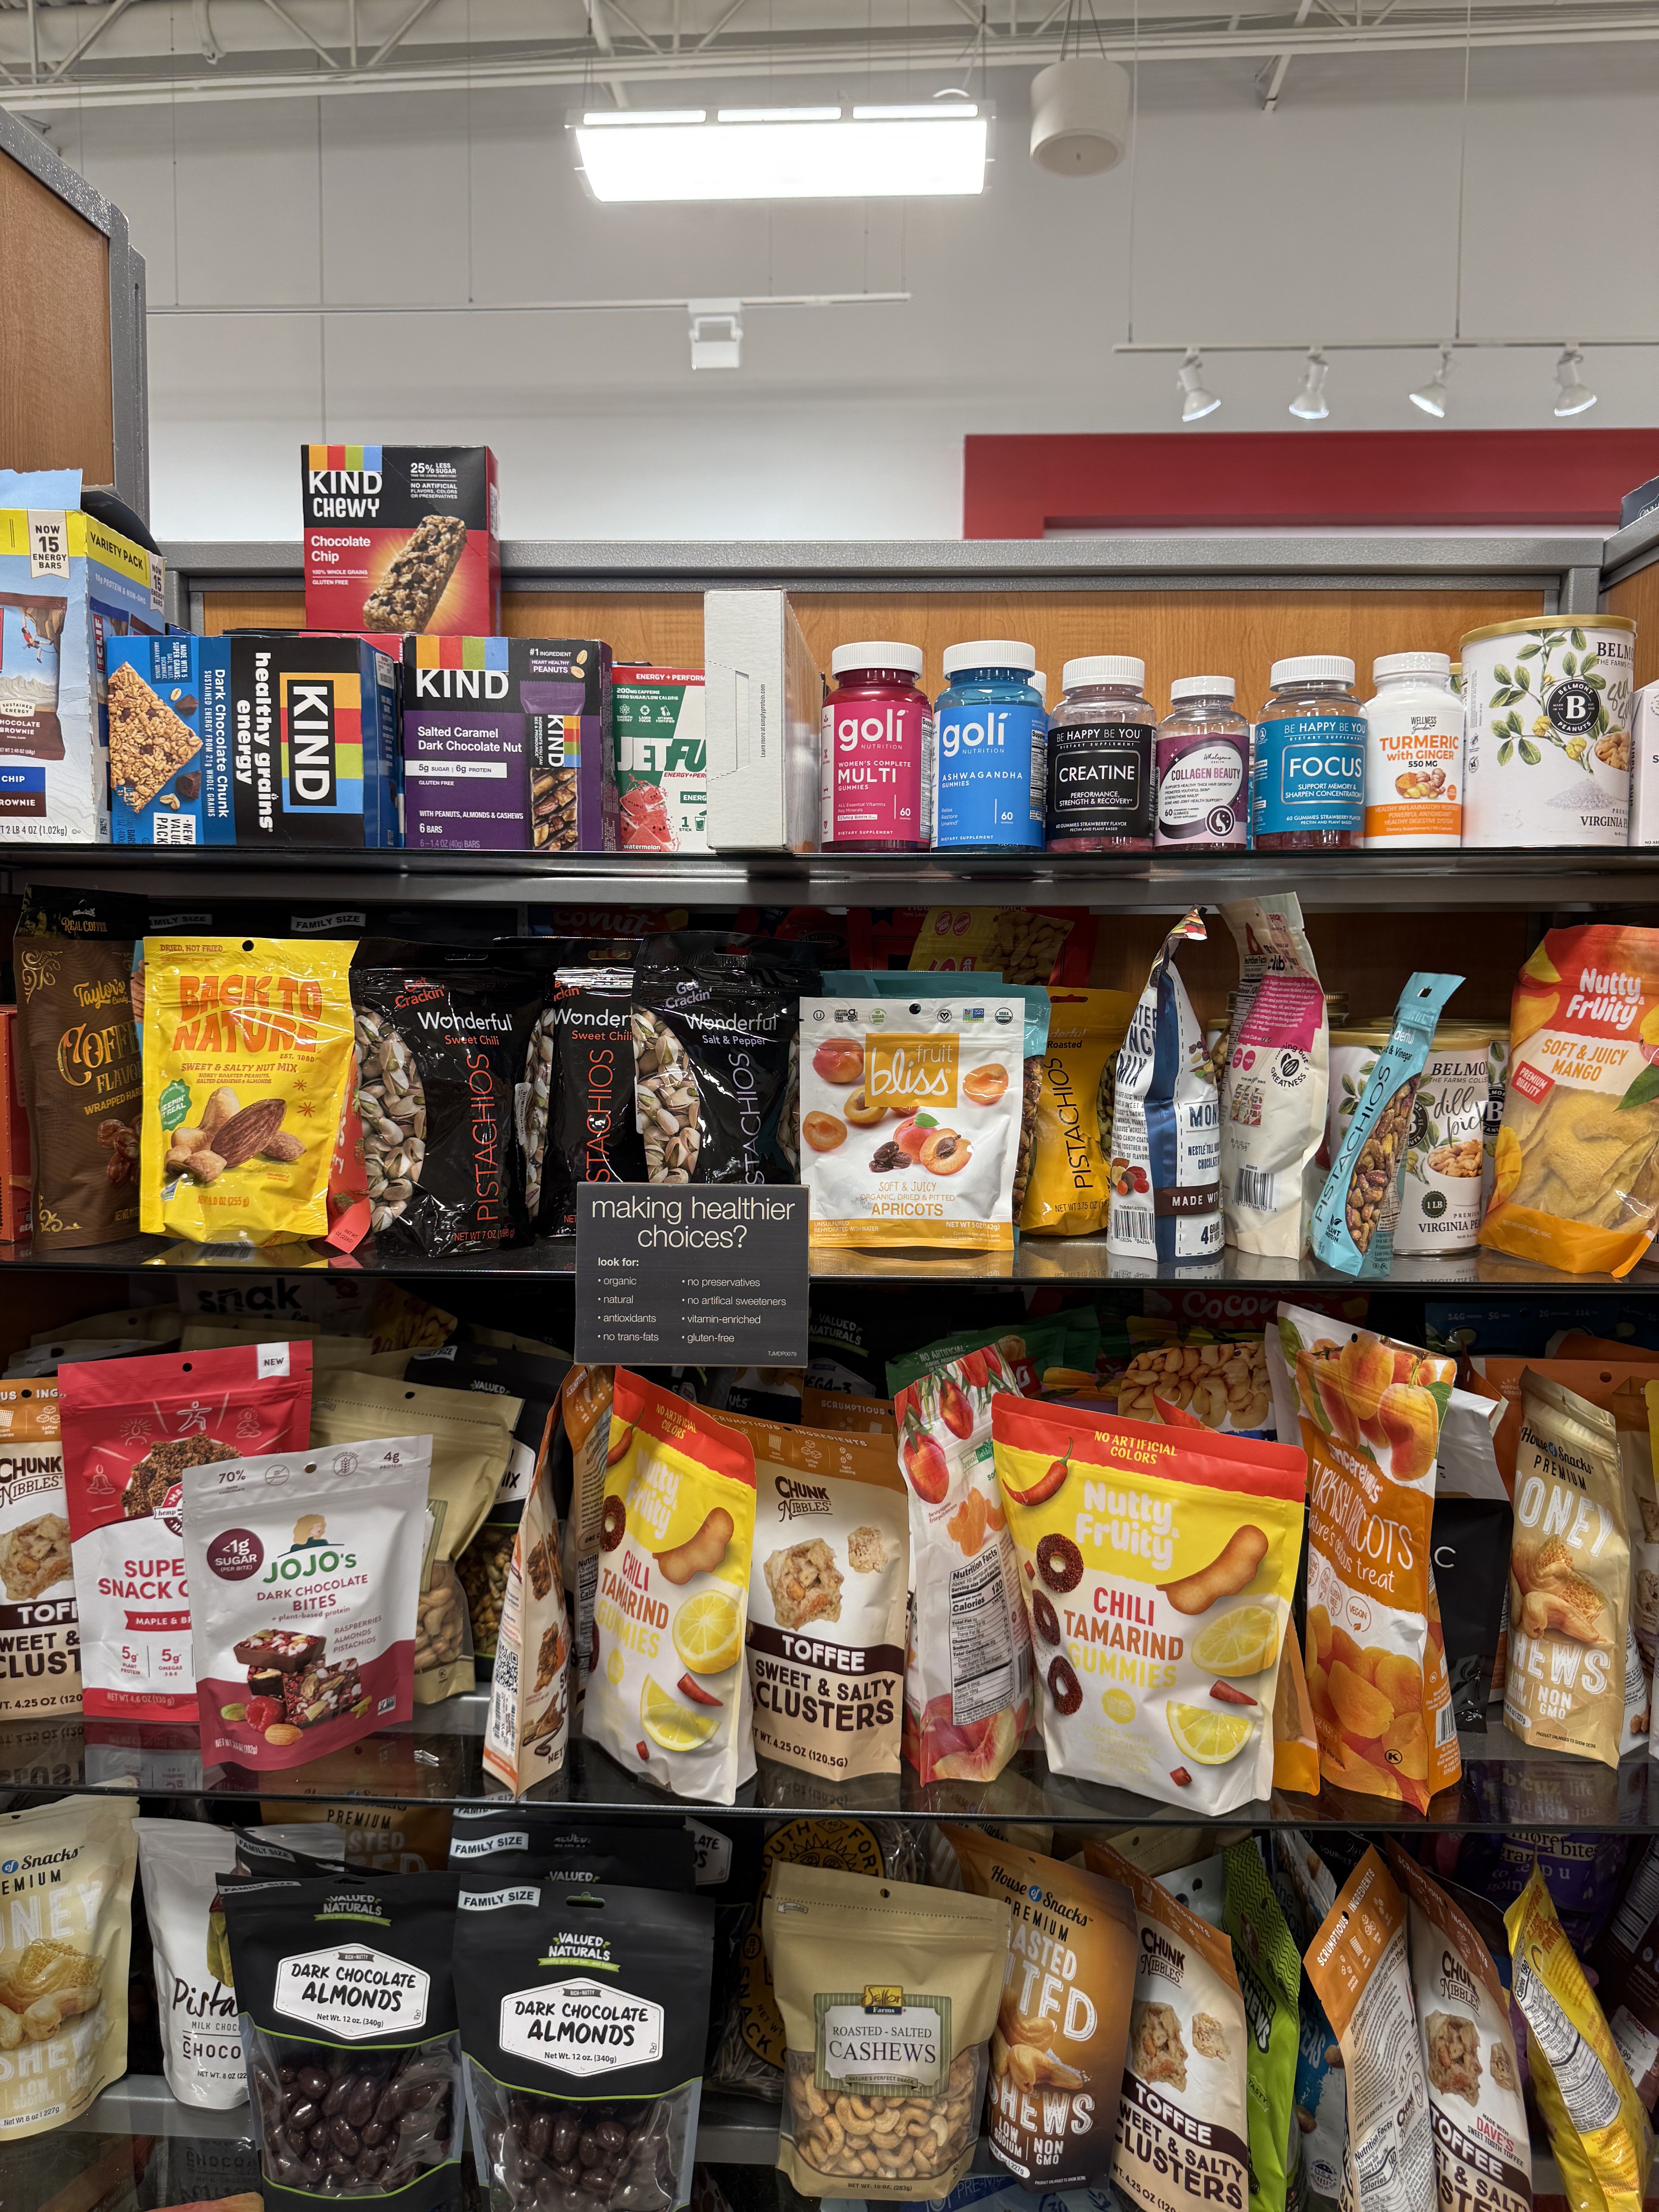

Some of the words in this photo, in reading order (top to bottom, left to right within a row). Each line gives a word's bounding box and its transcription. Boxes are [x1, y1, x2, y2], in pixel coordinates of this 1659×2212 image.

[410, 463, 434, 474] 25%
[309, 471, 383, 495] KIND
[36, 525, 60, 534] NOW
[39, 537, 59, 552] 15
[90, 531, 122, 559] VARIETY
[119, 548, 144, 570] PACK
[311, 536, 371, 548] Chocolate
[33, 553, 67, 562] ENERGY
[312, 550, 339, 564] Chip
[214, 669, 226, 701] Dark
[417, 669, 509, 699] KIND
[1558, 683, 1594, 696] BELMONT
[254, 652, 271, 747] healthy
[417, 727, 451, 739] Salted
[454, 727, 498, 739] Caramel
[838, 709, 907, 751] goli
[943, 712, 1009, 757] goli
[1057, 733, 1066, 742] BE
[1067, 729, 1100, 741] HAPPY
[1104, 729, 1115, 738] BE
[1119, 729, 1140, 739] YOU
[1557, 720, 1592, 732] PEANUTS
[215, 704, 227, 771] Chocolate
[236, 699, 251, 785] energy
[292, 685, 329, 800] KIND
[418, 740, 443, 752] Dark
[445, 741, 500, 752] Chocolate
[503, 742, 522, 753] Nut
[1379, 735, 1459, 751] TURMERIC
[1387, 750, 1411, 760] with
[1416, 750, 1454, 760] GINGER
[419, 763, 429, 773] 5g
[456, 764, 467, 774] 6g
[838, 768, 896, 783] MULTI
[942, 771, 1022, 781] ASHWAGANDHA
[1059, 765, 1135, 782] CREATINE
[1171, 768, 1211, 780] COLLAGEN
[1213, 768, 1240, 779] BEAUTY
[1290, 757, 1362, 777] FOCUS
[217, 775, 228, 818] Chunk
[254, 752, 276, 829] grains
[1580, 967, 1641, 1003] Nutty
[180, 975, 272, 1022] BACK
[280, 977, 322, 1024] TO
[172, 1010, 319, 1052] NATURE
[417, 1011, 513, 1032] Wonderful
[445, 1035, 477, 1045] Sweet
[480, 1034, 499, 1045] Chili
[916, 1044, 953, 1063] fruit
[1541, 1038, 1574, 1059] SOFT
[1577, 1045, 1586, 1060] &
[1588, 1048, 1628, 1066] JUICY
[182, 1063, 213, 1072] SWEET
[223, 1063, 254, 1072] SALTY
[256, 1063, 275, 1072] NUT
[277, 1063, 297, 1072] MIX
[871, 1048, 950, 1096] bliss
[1551, 1059, 1602, 1082] MANGO
[1515, 1078, 1541, 1097] QUALITY
[1518, 1066, 1548, 1090] PREMIUM
[1044, 1058, 1093, 1188] PISTACHIOS
[467, 1054, 498, 1221] PISTACHIOS
[879, 1181, 898, 1192] SOFT
[902, 1182, 909, 1191] &
[912, 1182, 936, 1192] JUICY
[592, 1195, 682, 1224] making
[692, 1196, 795, 1220] healthier
[872, 1204, 943, 1216] APRICOTS
[637, 1225, 747, 1248] choices?
[598, 1258, 619, 1266] look
[622, 1258, 639, 1266] for:
[604, 1277, 637, 1286] organic
[702, 1278, 760, 1288] preservatives
[603, 1295, 634, 1303] natural
[735, 1297, 786, 1306] sweeteners
[603, 1314, 656, 1323] antioxidants
[687, 1315, 761, 1324] vitamin-enriched
[618, 1333, 659, 1341] trans-fats
[687, 1333, 735, 1343] gluten-free
[264, 1357, 284, 1367] NEW
[1094, 1431, 1110, 1443] NO
[1111, 1435, 1178, 1458] ARTIFICIAL
[1110, 1447, 1158, 1465] COLORS
[219, 1470, 246, 1484] 70%
[775, 1475, 830, 1500] CHUNK
[778, 1499, 833, 1522] NIBBLES
[215, 1553, 257, 1566] SUGAR
[257, 1588, 293, 1601] DARK
[295, 1575, 368, 1597] CHOCOLATE
[293, 1595, 337, 1611] BITES
[1093, 1587, 1155, 1626] CHILI
[1064, 1610, 1184, 1661] TAMARIND
[781, 1634, 866, 1671] TOFFEE
[1068, 1642, 1177, 1689] GUMMIES
[755, 1658, 812, 1686] SWEET
[817, 1677, 830, 1697] &
[837, 1679, 896, 1701] SALTY
[756, 1681, 894, 1732] CLUSTERS
[21, 1847, 79, 1870] Snacks
[465, 1894, 505, 1908] FAMILY
[508, 1890, 534, 1903] SIZE
[991, 1866, 1027, 1895] House
[1030, 1887, 1040, 1900] of
[1042, 1892, 1088, 1927] Snacks
[558, 1932, 603, 1947] VALUED
[549, 1945, 611, 1961] NATURALS
[292, 1964, 330, 1979] DARK
[336, 1967, 416, 1988] CHOCOLATE
[302, 1983, 403, 2012] ALMONDS
[515, 2001, 555, 2017] DARK
[562, 2002, 648, 2023] CHOCOLATE
[527, 2019, 635, 2047] ALMONDS
[833, 2027, 882, 2037] ROASTED
[891, 2027, 932, 2038] SALTED
[544, 2051, 556, 2060] Net
[558, 2052, 570, 2061] Wt.
[594, 2054, 617, 2064] (340g)
[828, 2041, 936, 2064] CASHEWS
